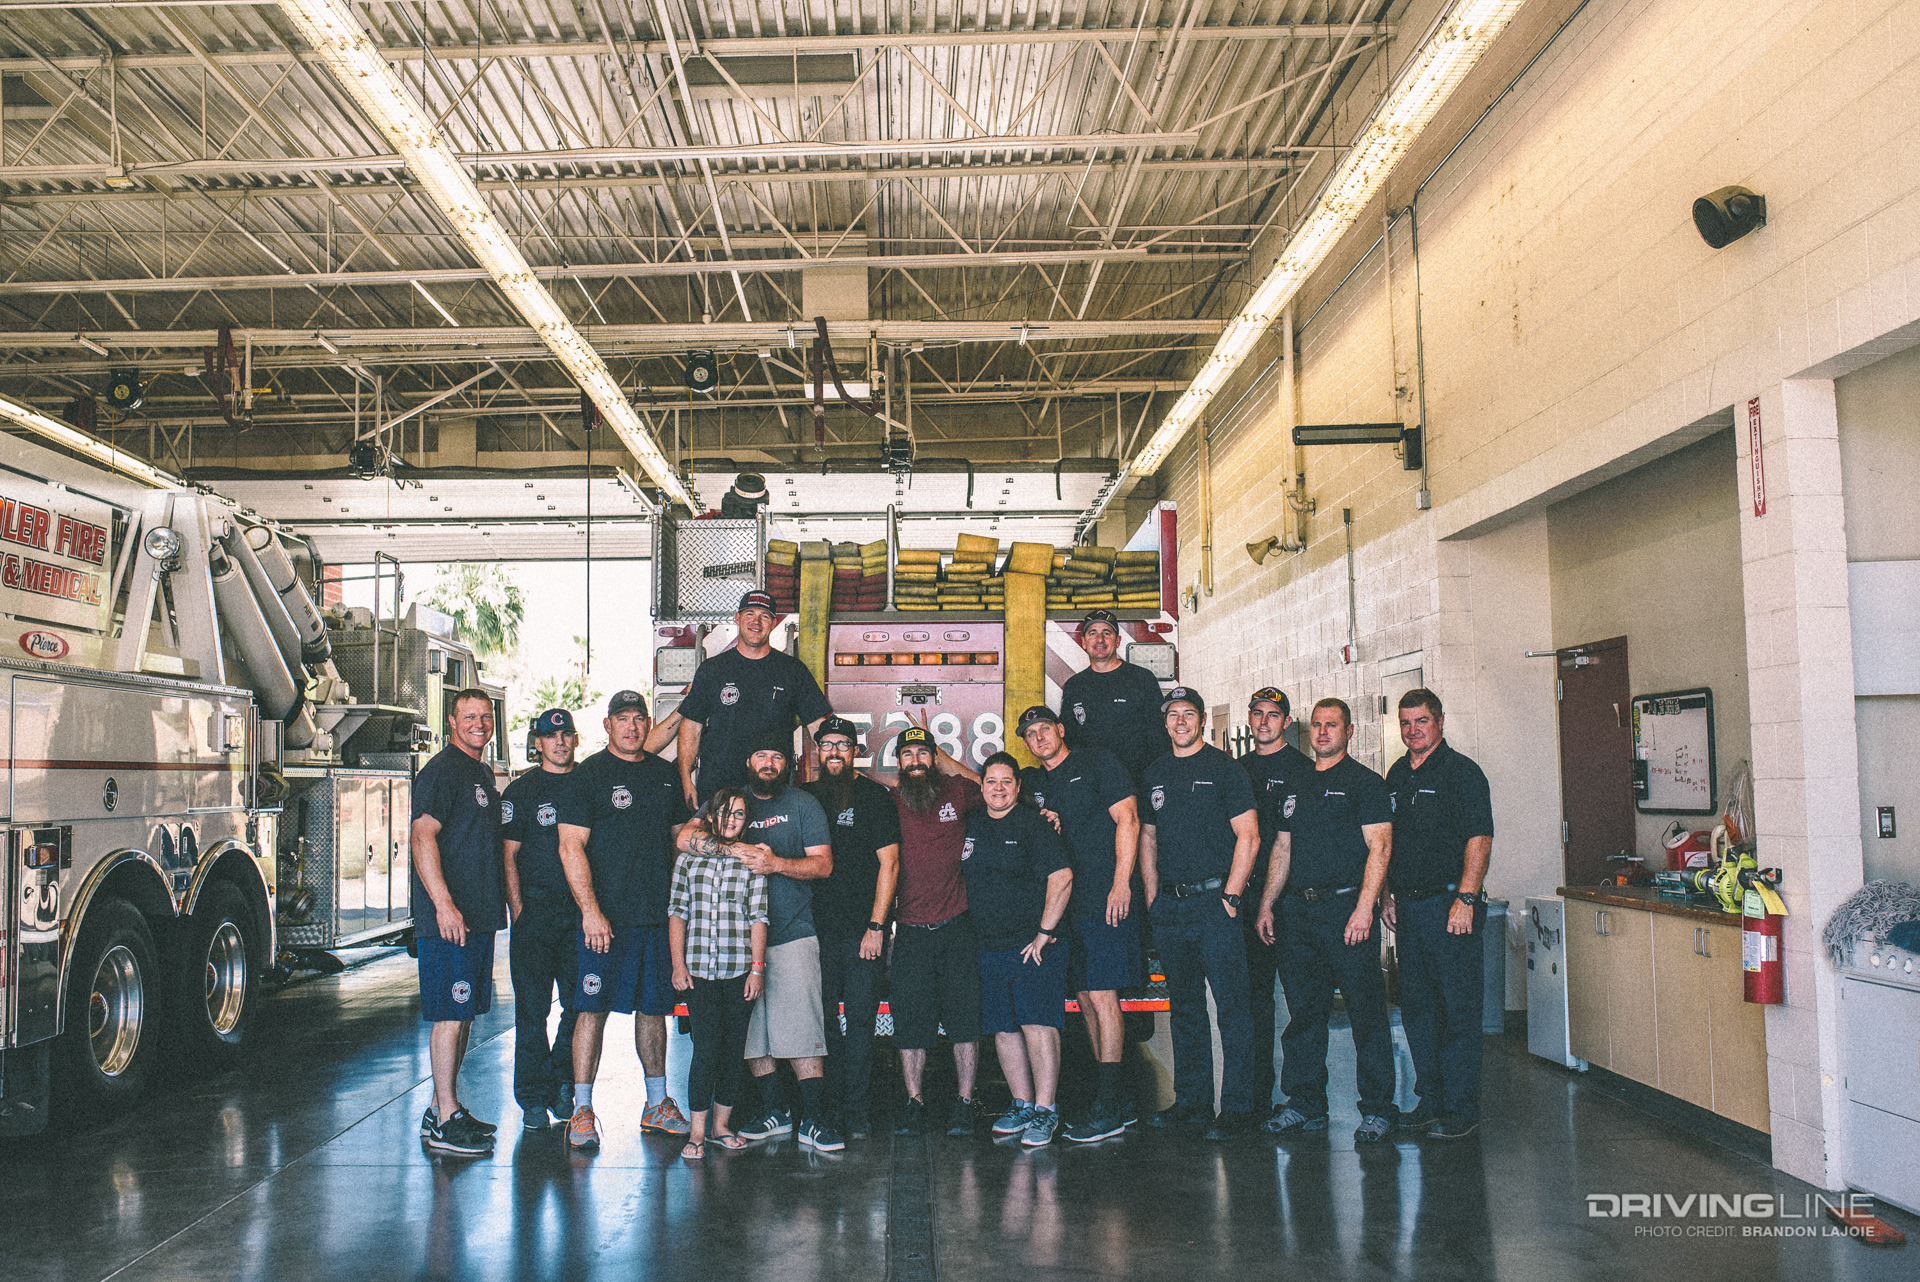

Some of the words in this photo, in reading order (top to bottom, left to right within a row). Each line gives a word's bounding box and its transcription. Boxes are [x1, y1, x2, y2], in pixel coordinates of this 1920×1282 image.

[1753, 418, 1762, 507] EXTINGUISHER
[0, 495, 49, 552] LER
[53, 513, 107, 566] FIRE
[2, 553, 20, 589] &
[20, 557, 102, 606] MEDICAL
[30, 633, 58, 652] Pierce
